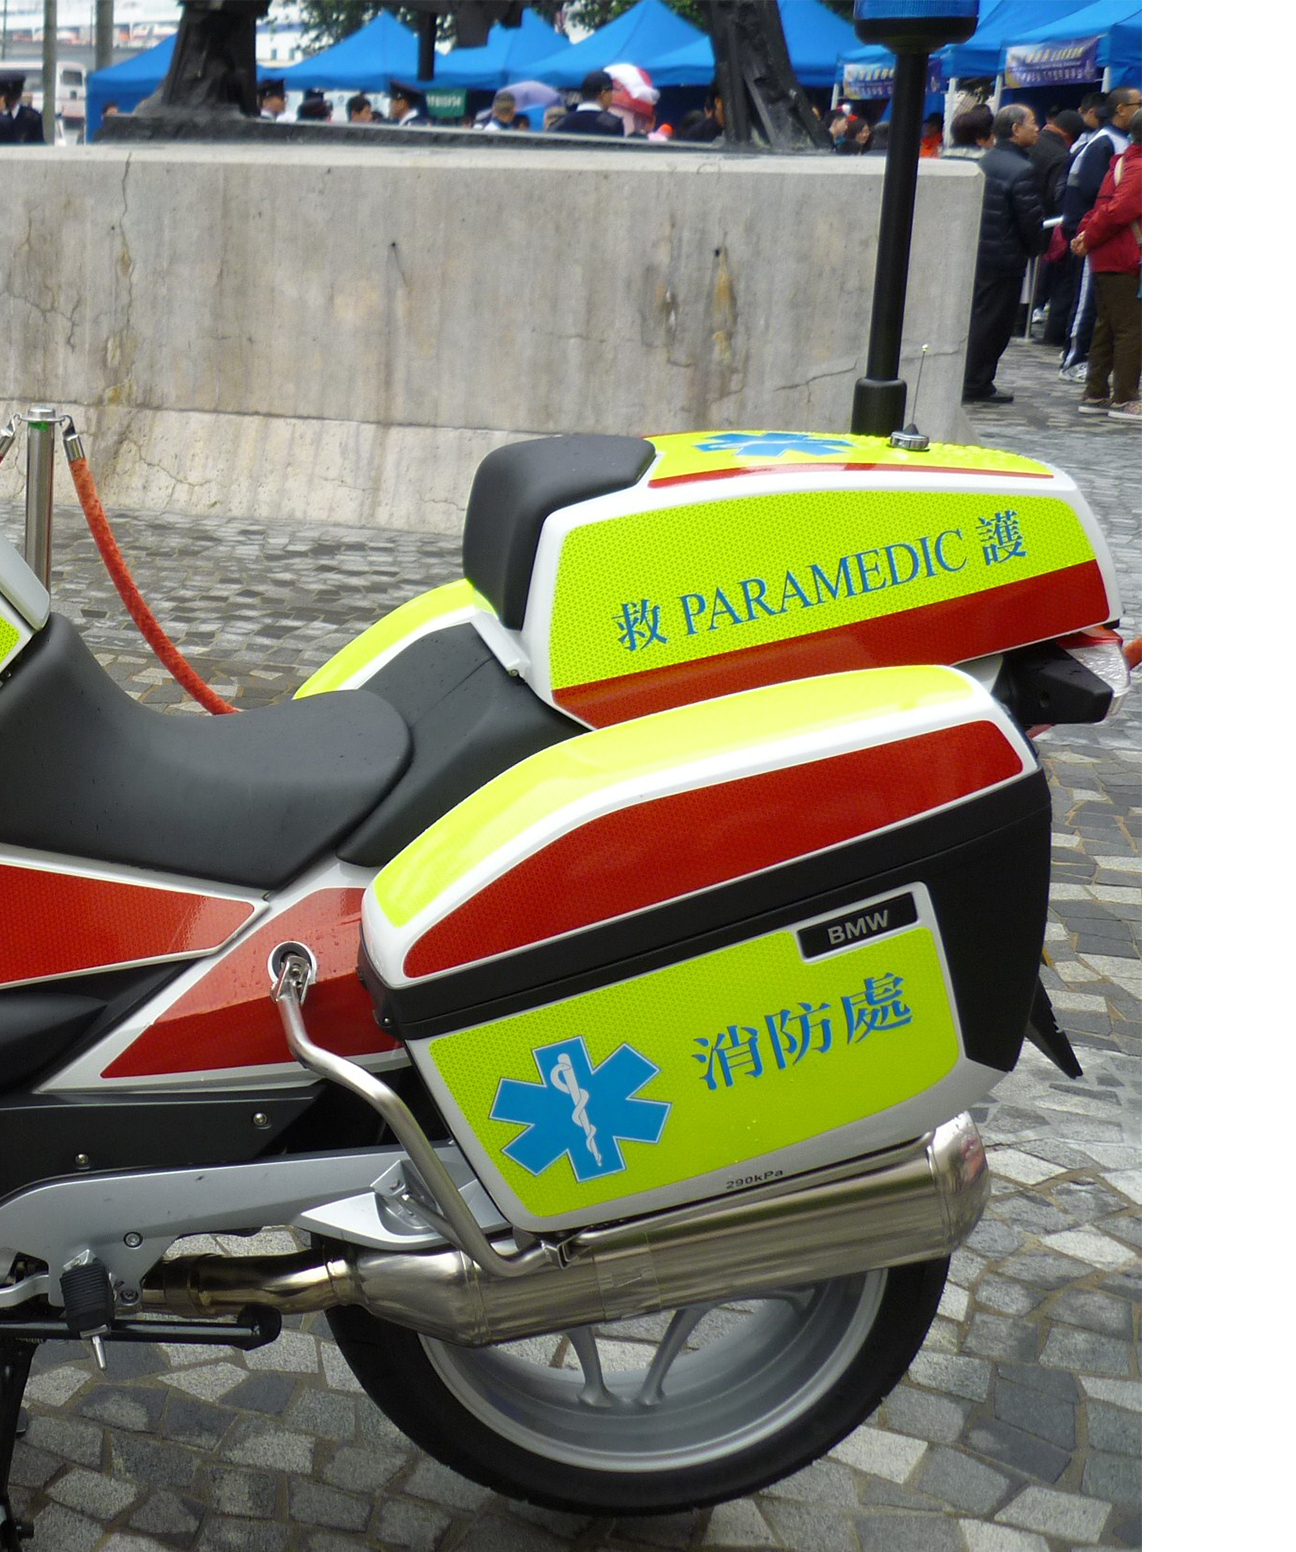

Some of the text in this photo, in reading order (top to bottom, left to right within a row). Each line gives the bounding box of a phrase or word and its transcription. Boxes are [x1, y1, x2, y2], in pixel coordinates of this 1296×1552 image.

[611, 510, 1027, 652] 救 PARAMEDIC 護
[827, 910, 888, 945] BMW
[692, 972, 912, 1091] 消防處
[726, 1169, 784, 1190] 290kPa
